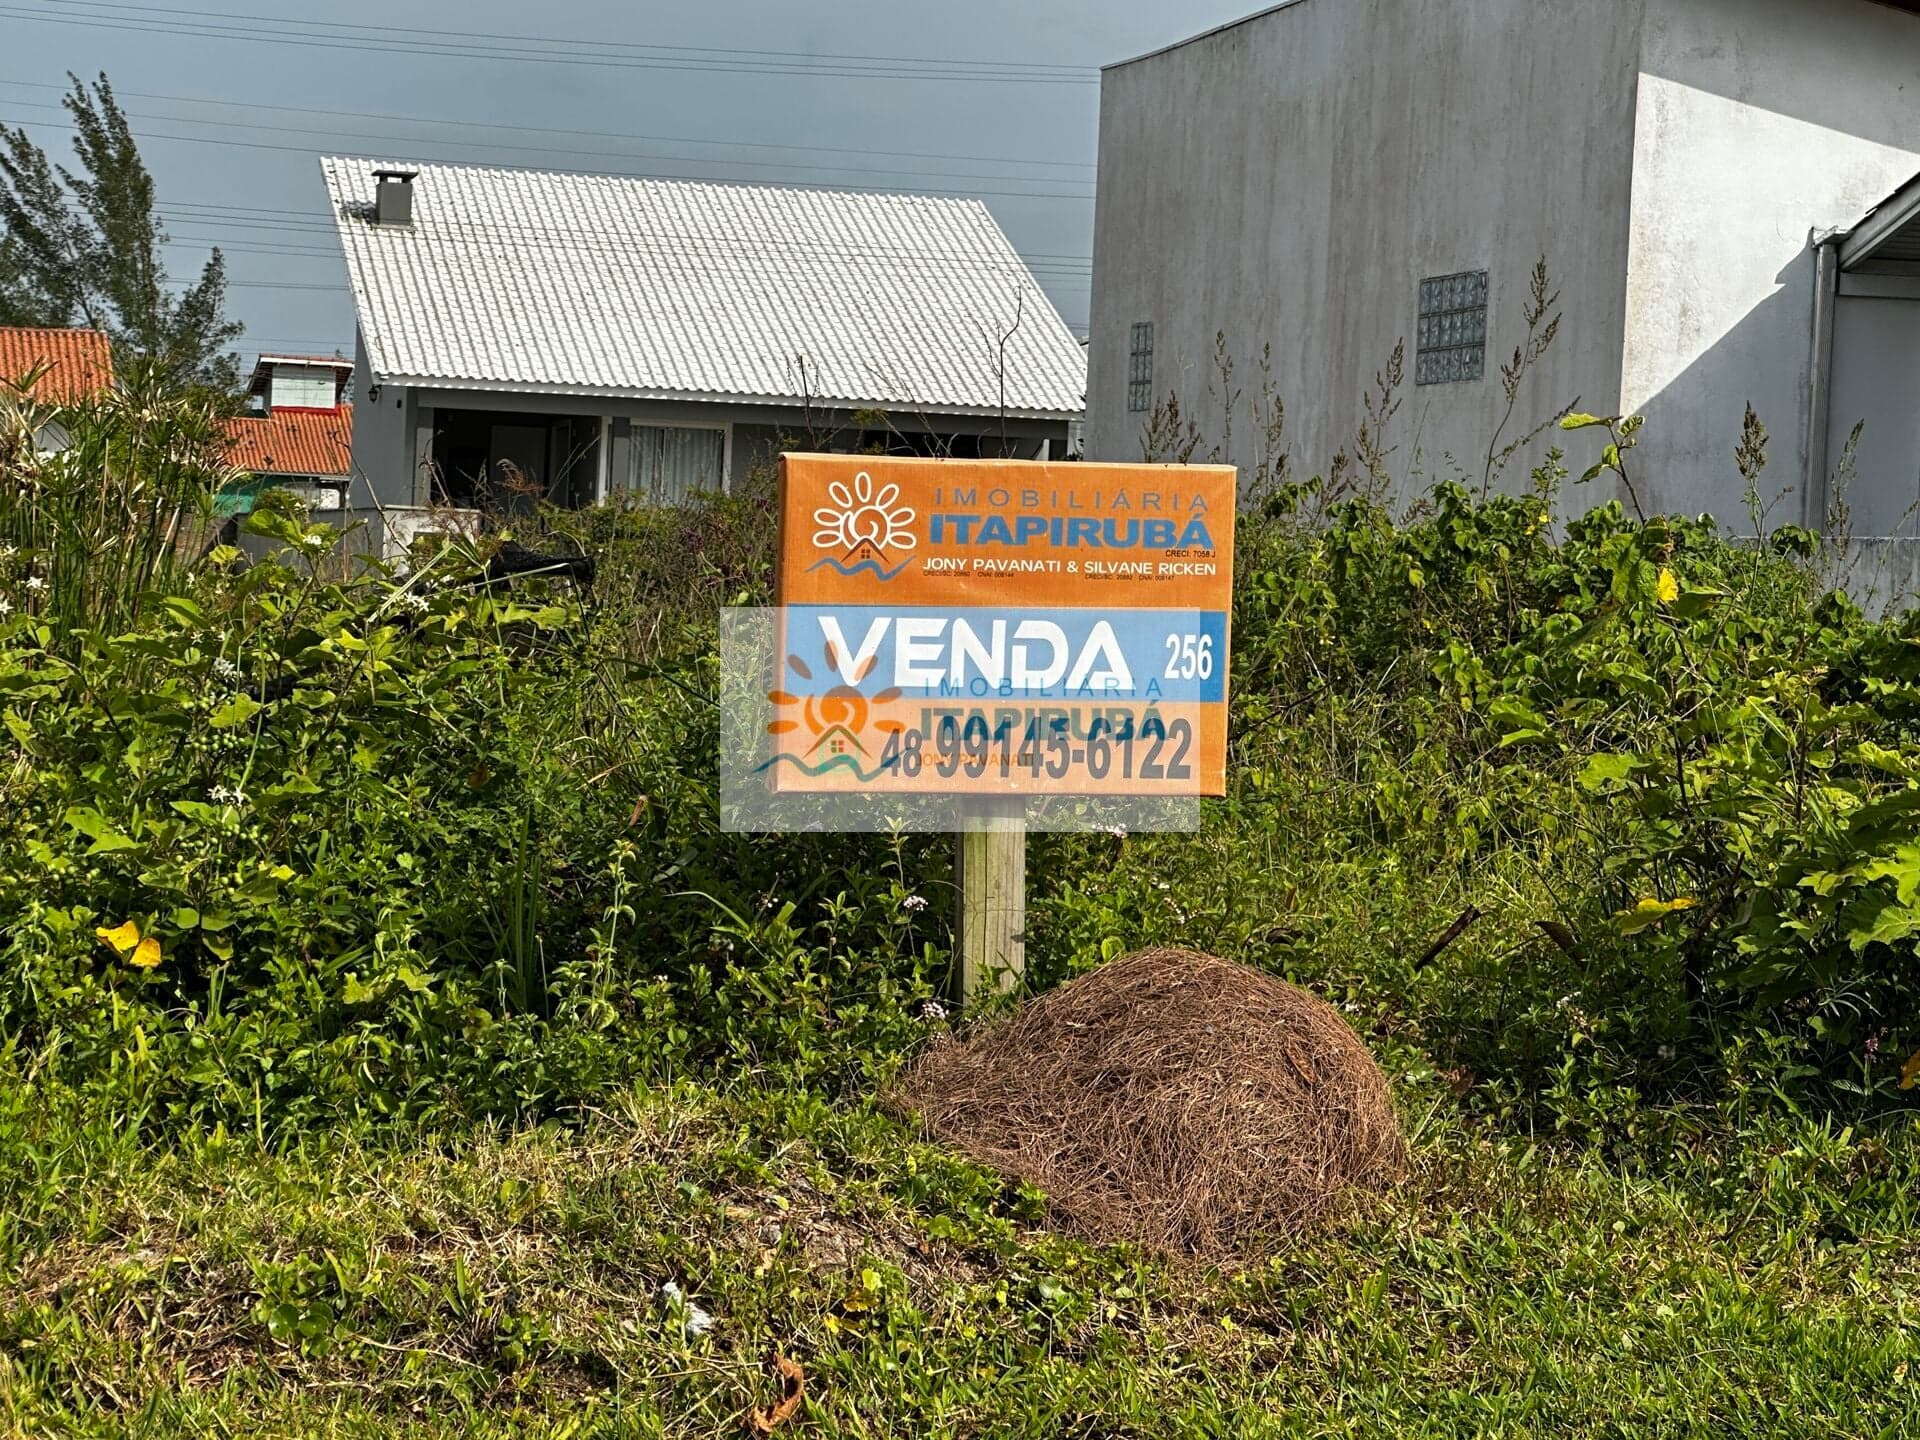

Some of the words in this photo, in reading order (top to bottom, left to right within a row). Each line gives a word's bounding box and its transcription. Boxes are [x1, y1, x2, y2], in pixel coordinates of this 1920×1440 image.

[935, 487, 1209, 512] IMOBILIÁRIA
[929, 513, 1215, 550] ITAPIRUBÁ
[923, 557, 968, 571] JONY
[973, 558, 1060, 574] PAVANATI
[1066, 562, 1078, 574] &
[1083, 561, 1153, 575] SILVANE
[1158, 563, 1216, 576] RICKEN
[817, 615, 1136, 690] VENDA
[1165, 634, 1213, 681] 256
[880, 728, 923, 778] 48
[936, 715, 1192, 780] 99145-6122
